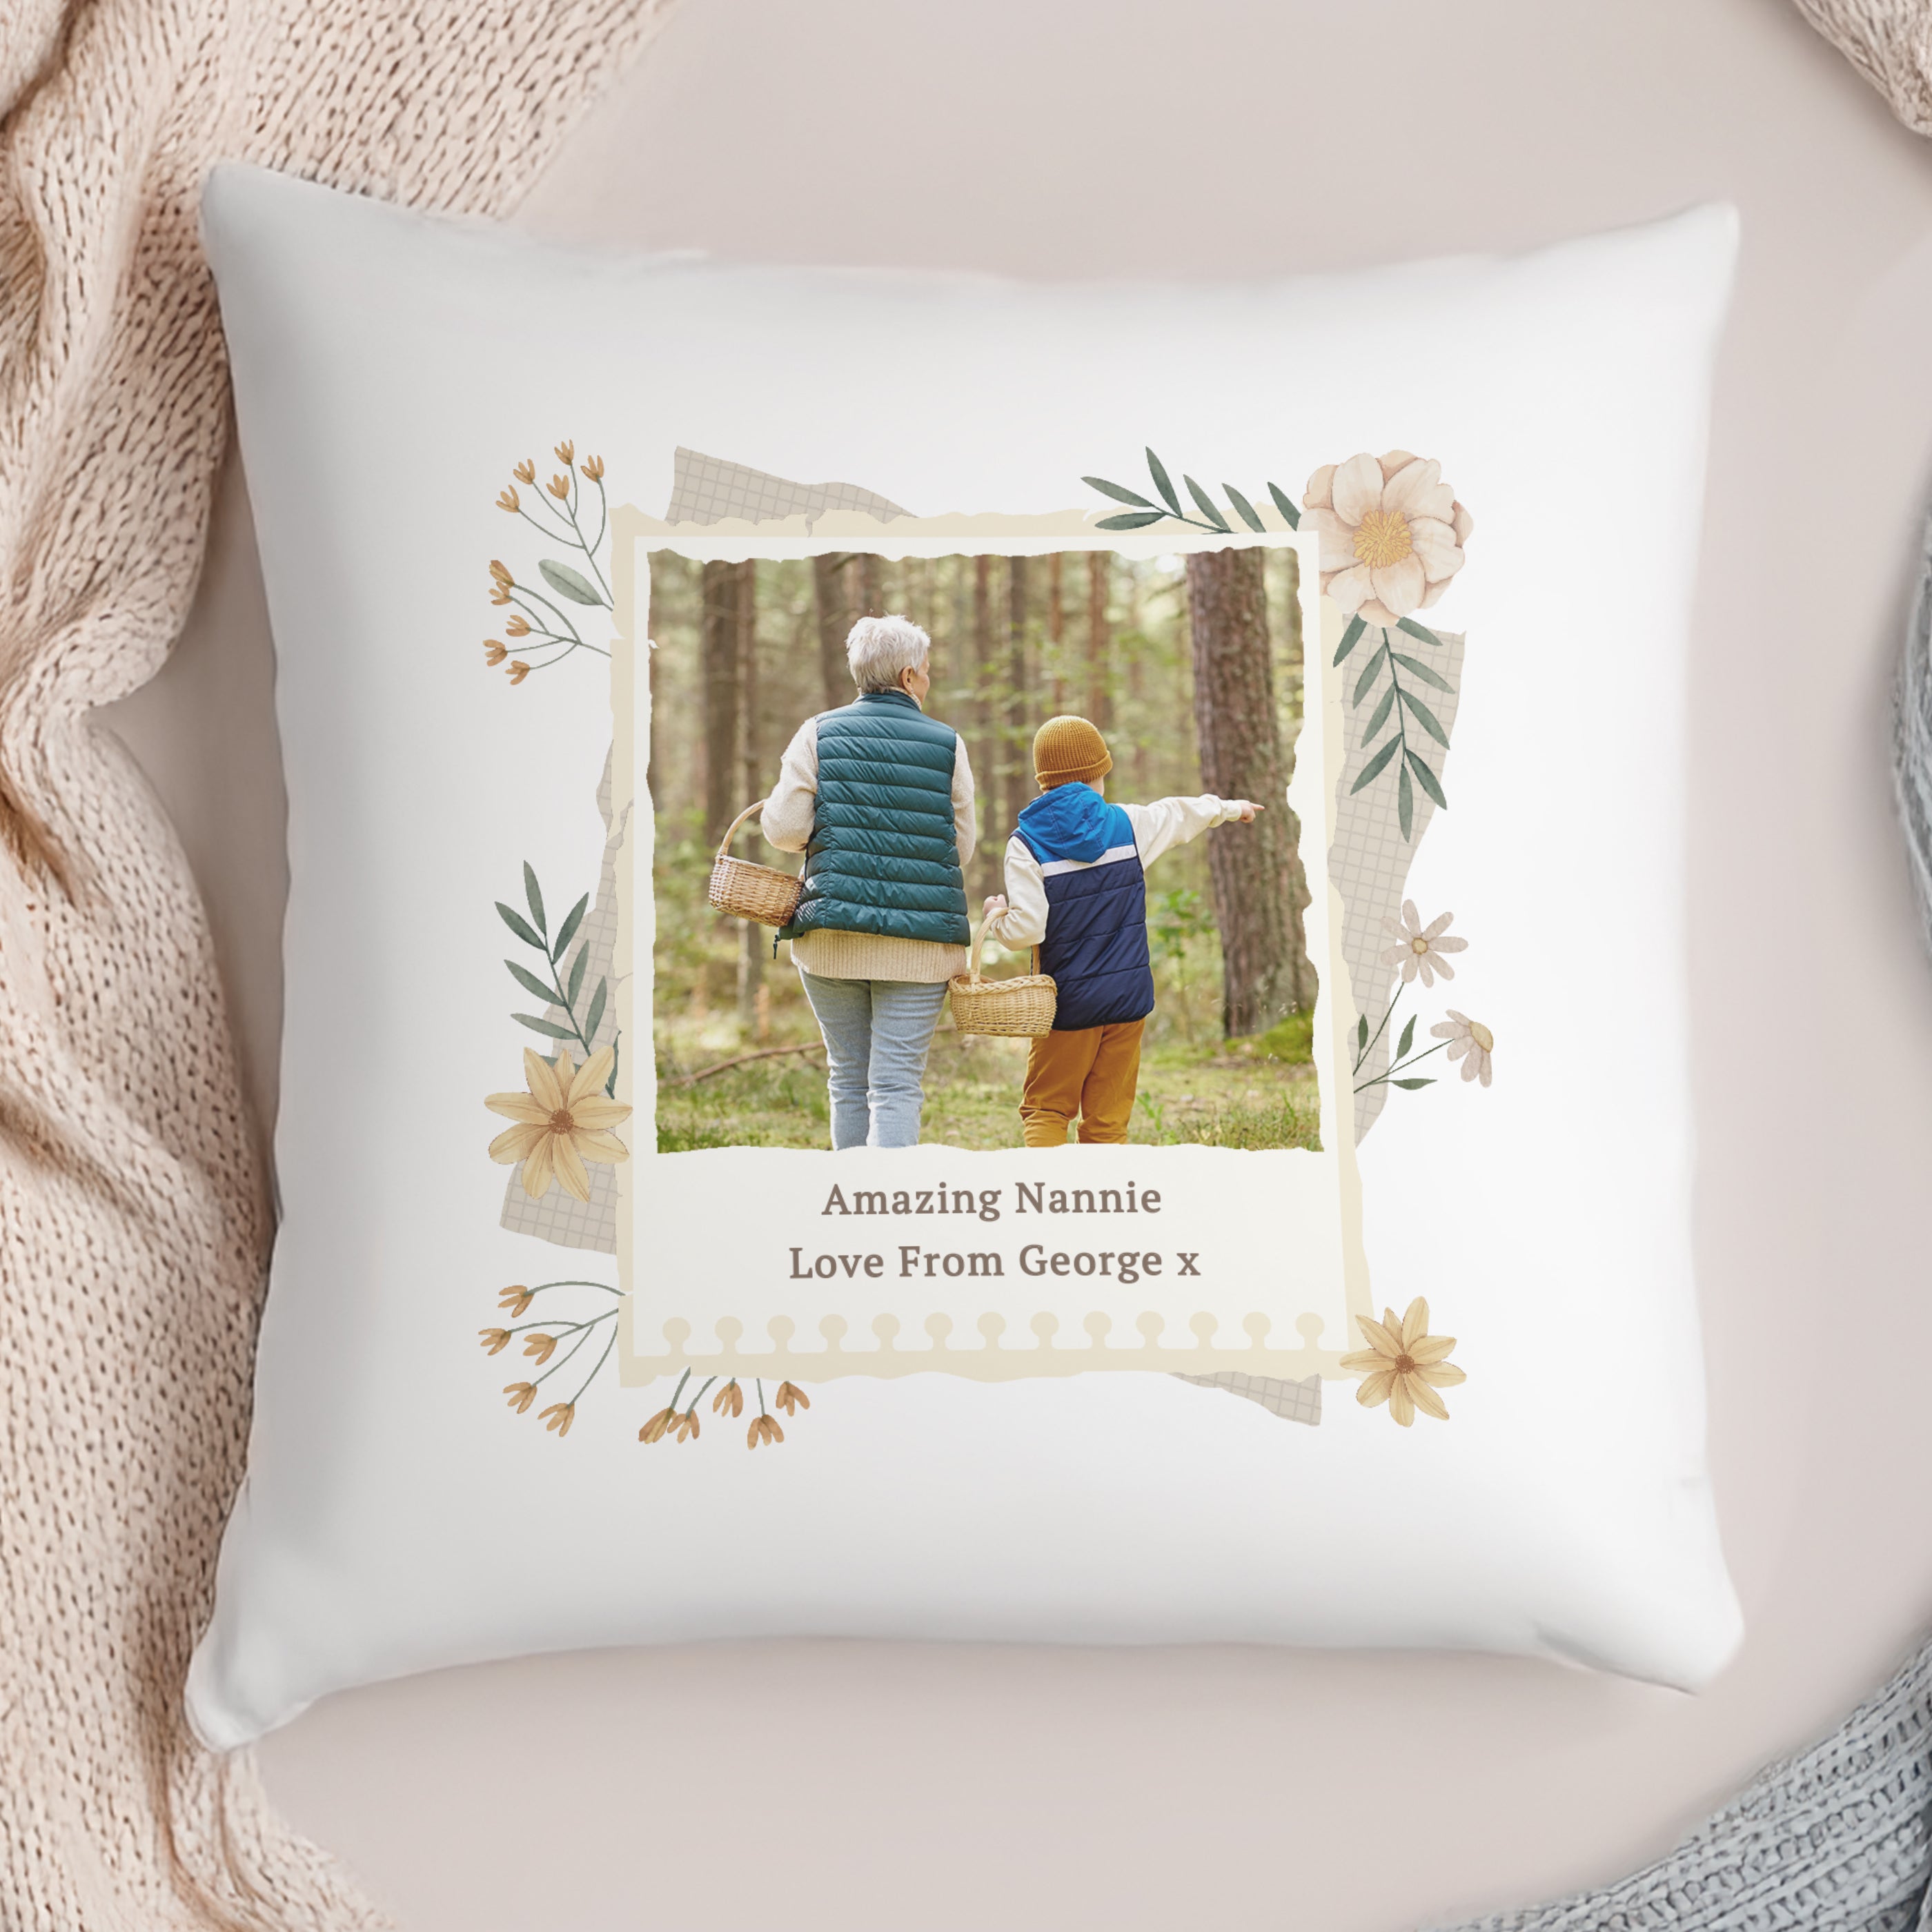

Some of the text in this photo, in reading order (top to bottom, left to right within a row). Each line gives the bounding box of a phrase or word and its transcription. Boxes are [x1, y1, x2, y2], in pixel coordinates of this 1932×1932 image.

[821, 1181, 1162, 1222] Amazing Nannie
[789, 1244, 1201, 1284] Love From George x
